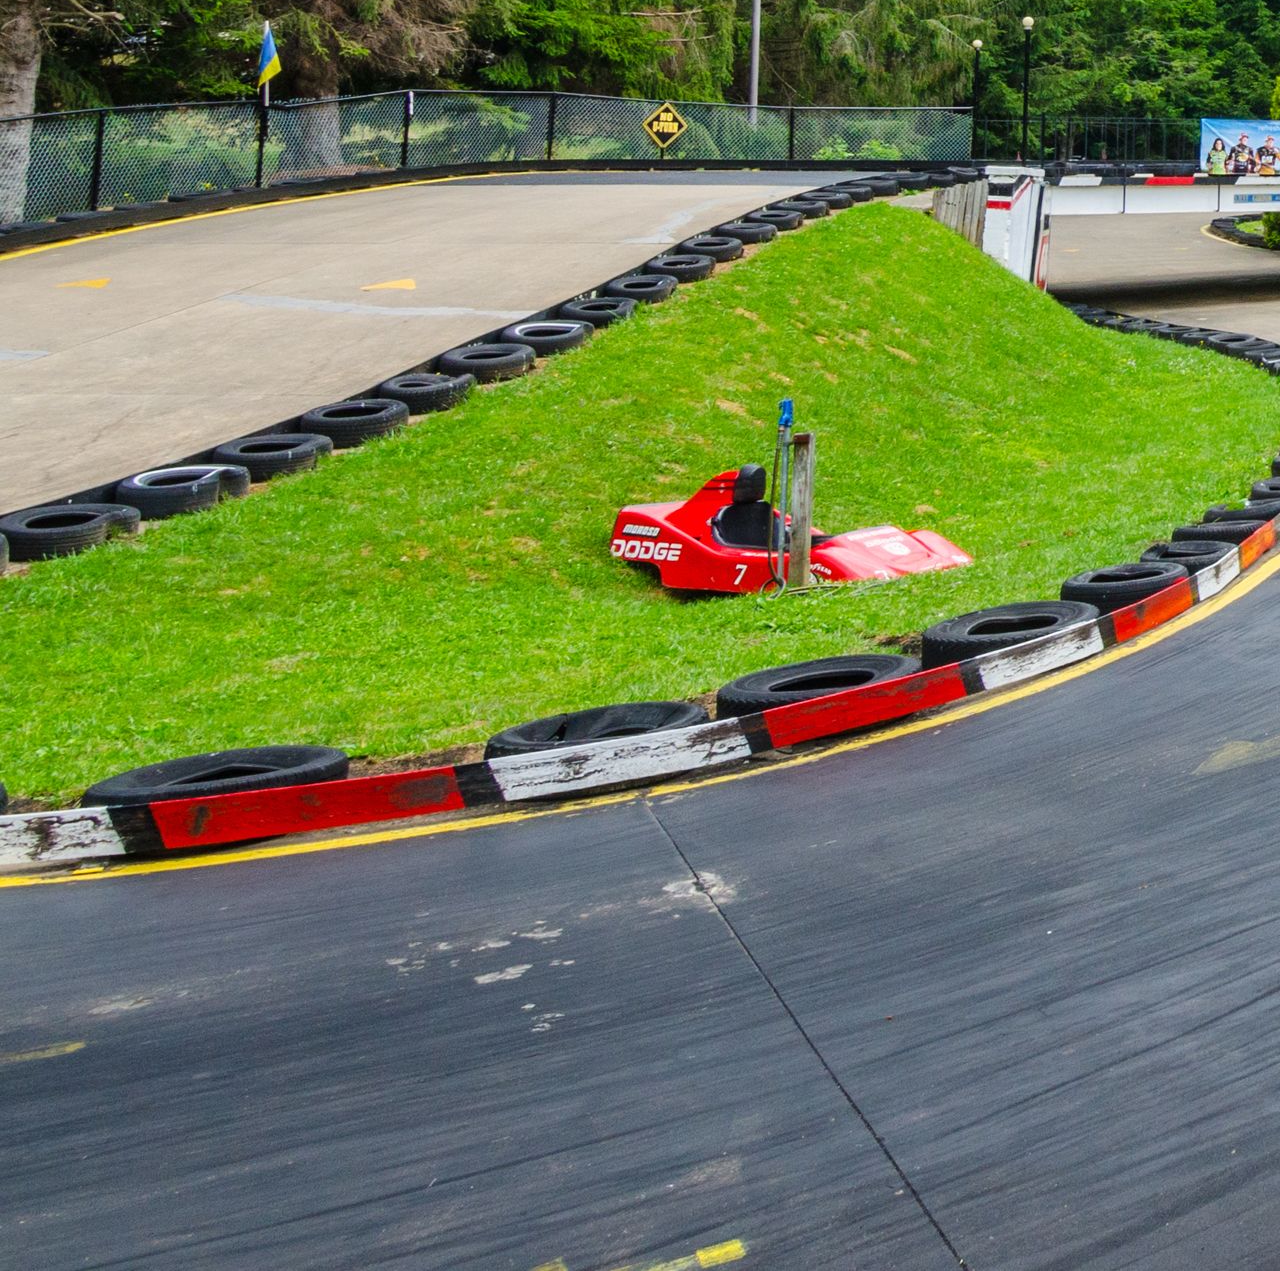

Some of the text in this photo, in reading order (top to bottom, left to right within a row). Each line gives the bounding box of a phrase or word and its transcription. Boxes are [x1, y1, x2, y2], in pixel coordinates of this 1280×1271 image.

[660, 112, 673, 122] NO
[611, 539, 683, 562] DODGE
[734, 564, 748, 585] 7
